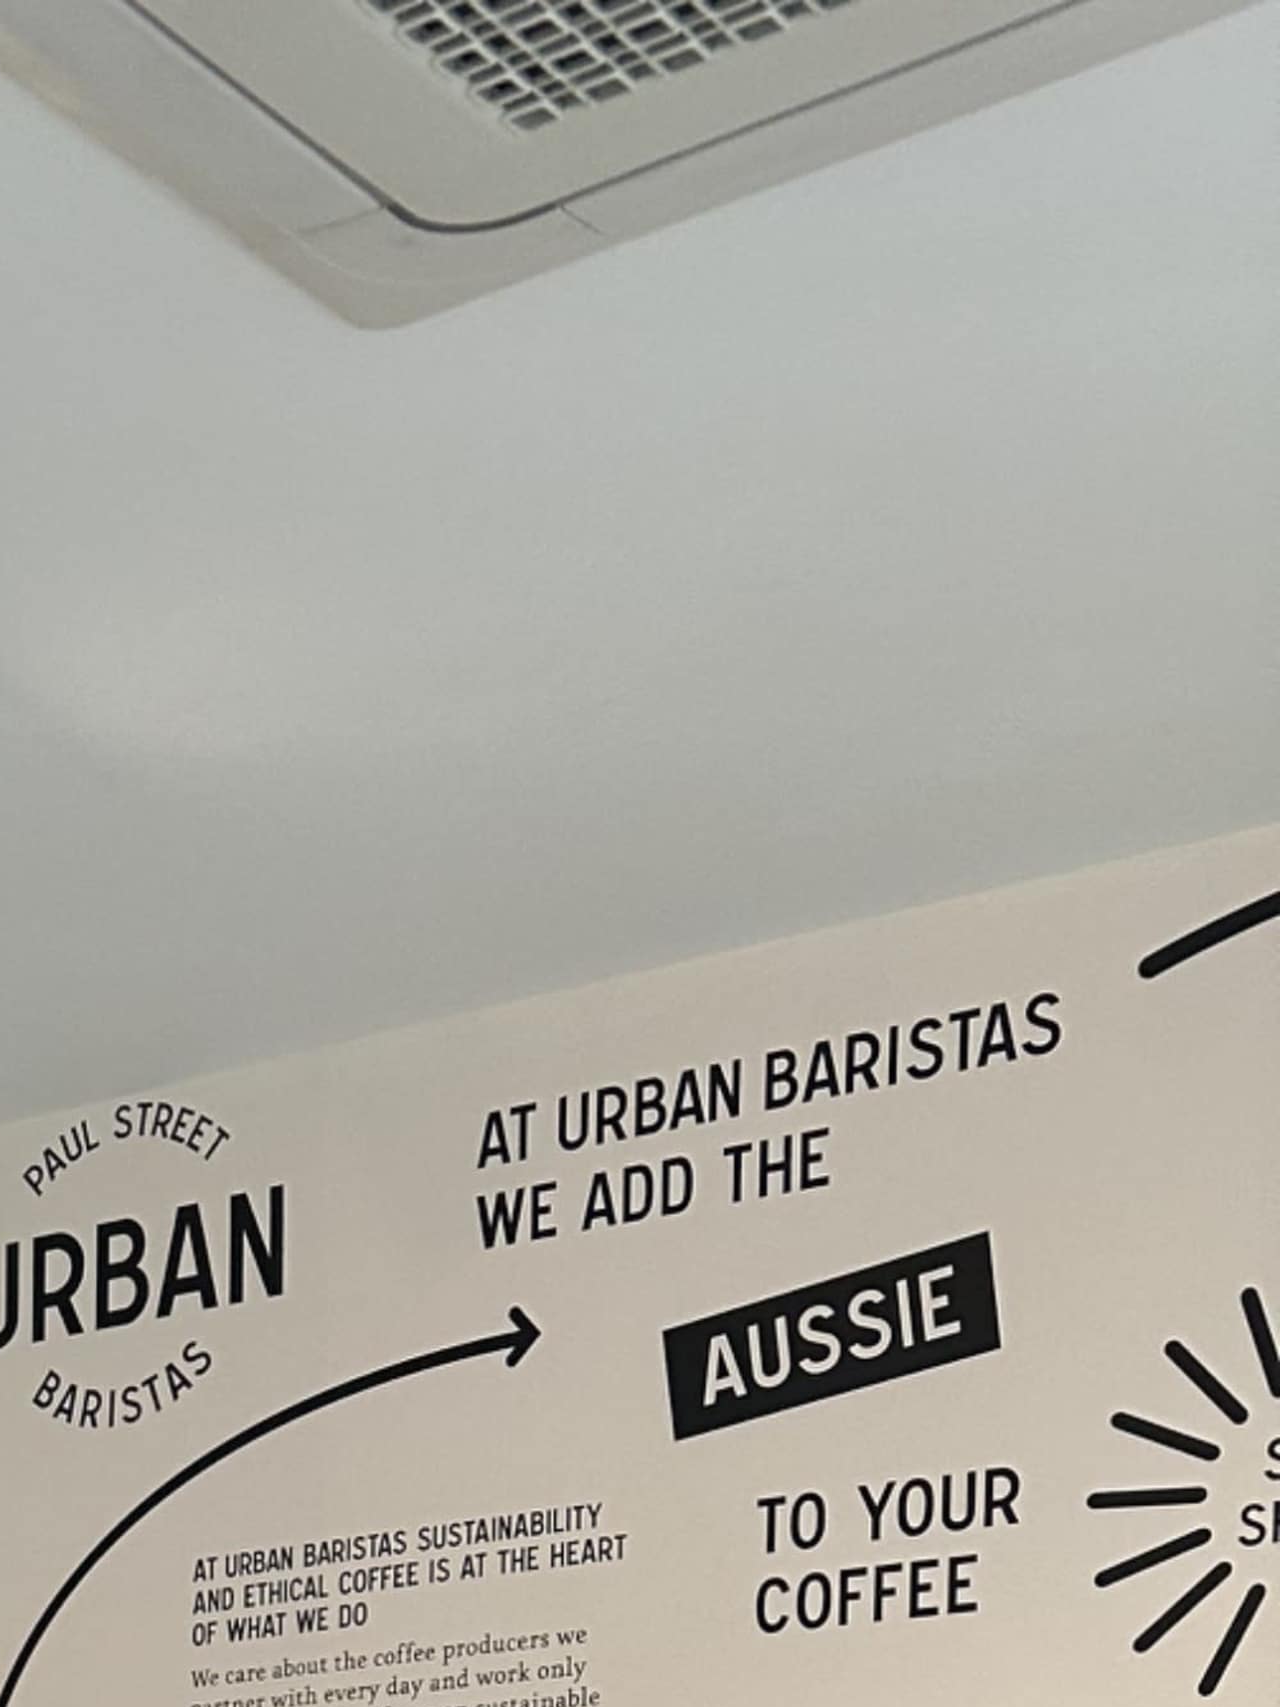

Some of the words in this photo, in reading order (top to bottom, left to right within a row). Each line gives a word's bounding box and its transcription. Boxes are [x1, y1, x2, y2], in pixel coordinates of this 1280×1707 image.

[477, 1103, 536, 1169] AT
[559, 1059, 740, 1150] URBAN
[765, 993, 1060, 1110] BARISTAS
[22, 1120, 100, 1197] PAUL
[113, 1101, 230, 1161] STREET
[477, 1181, 557, 1249] WE
[582, 1157, 693, 1230] ADD
[723, 1128, 829, 1202] THE
[703, 1264, 962, 1407] AUSSIE
[32, 1340, 212, 1428] BARISTAS
[193, 1557, 218, 1582] AT
[225, 1546, 293, 1578] URBAN
[304, 1531, 407, 1567] BARISTAS
[418, 1503, 602, 1551] SUSTAINABILITY
[757, 1493, 825, 1553] TO
[858, 1468, 1019, 1540] YOUR
[193, 1587, 234, 1614] AND
[244, 1575, 328, 1608] ETHICAL
[339, 1562, 418, 1595] COFFEE
[429, 1558, 450, 1583] IS
[460, 1552, 487, 1579] AT
[497, 1546, 539, 1574] THE
[551, 1534, 627, 1568] HEART
[757, 1554, 977, 1633] COFFEE
[191, 1669, 219, 1688] We
[225, 1668, 266, 1684] care
[272, 1658, 327, 1679] about
[334, 1650, 367, 1671] the
[373, 1642, 435, 1667] coffee
[443, 1633, 549, 1666] producers
[556, 1630, 587, 1645] we
[192, 1621, 217, 1646] OF
[227, 1612, 286, 1642] WHAT
[297, 1607, 328, 1633] WE
[339, 1602, 367, 1628] DO
[324, 1684, 380, 1705] every
[386, 1675, 423, 1700] day
[429, 1667, 469, 1692] and
[476, 1661, 530, 1686] work
[537, 1656, 587, 1684] only
